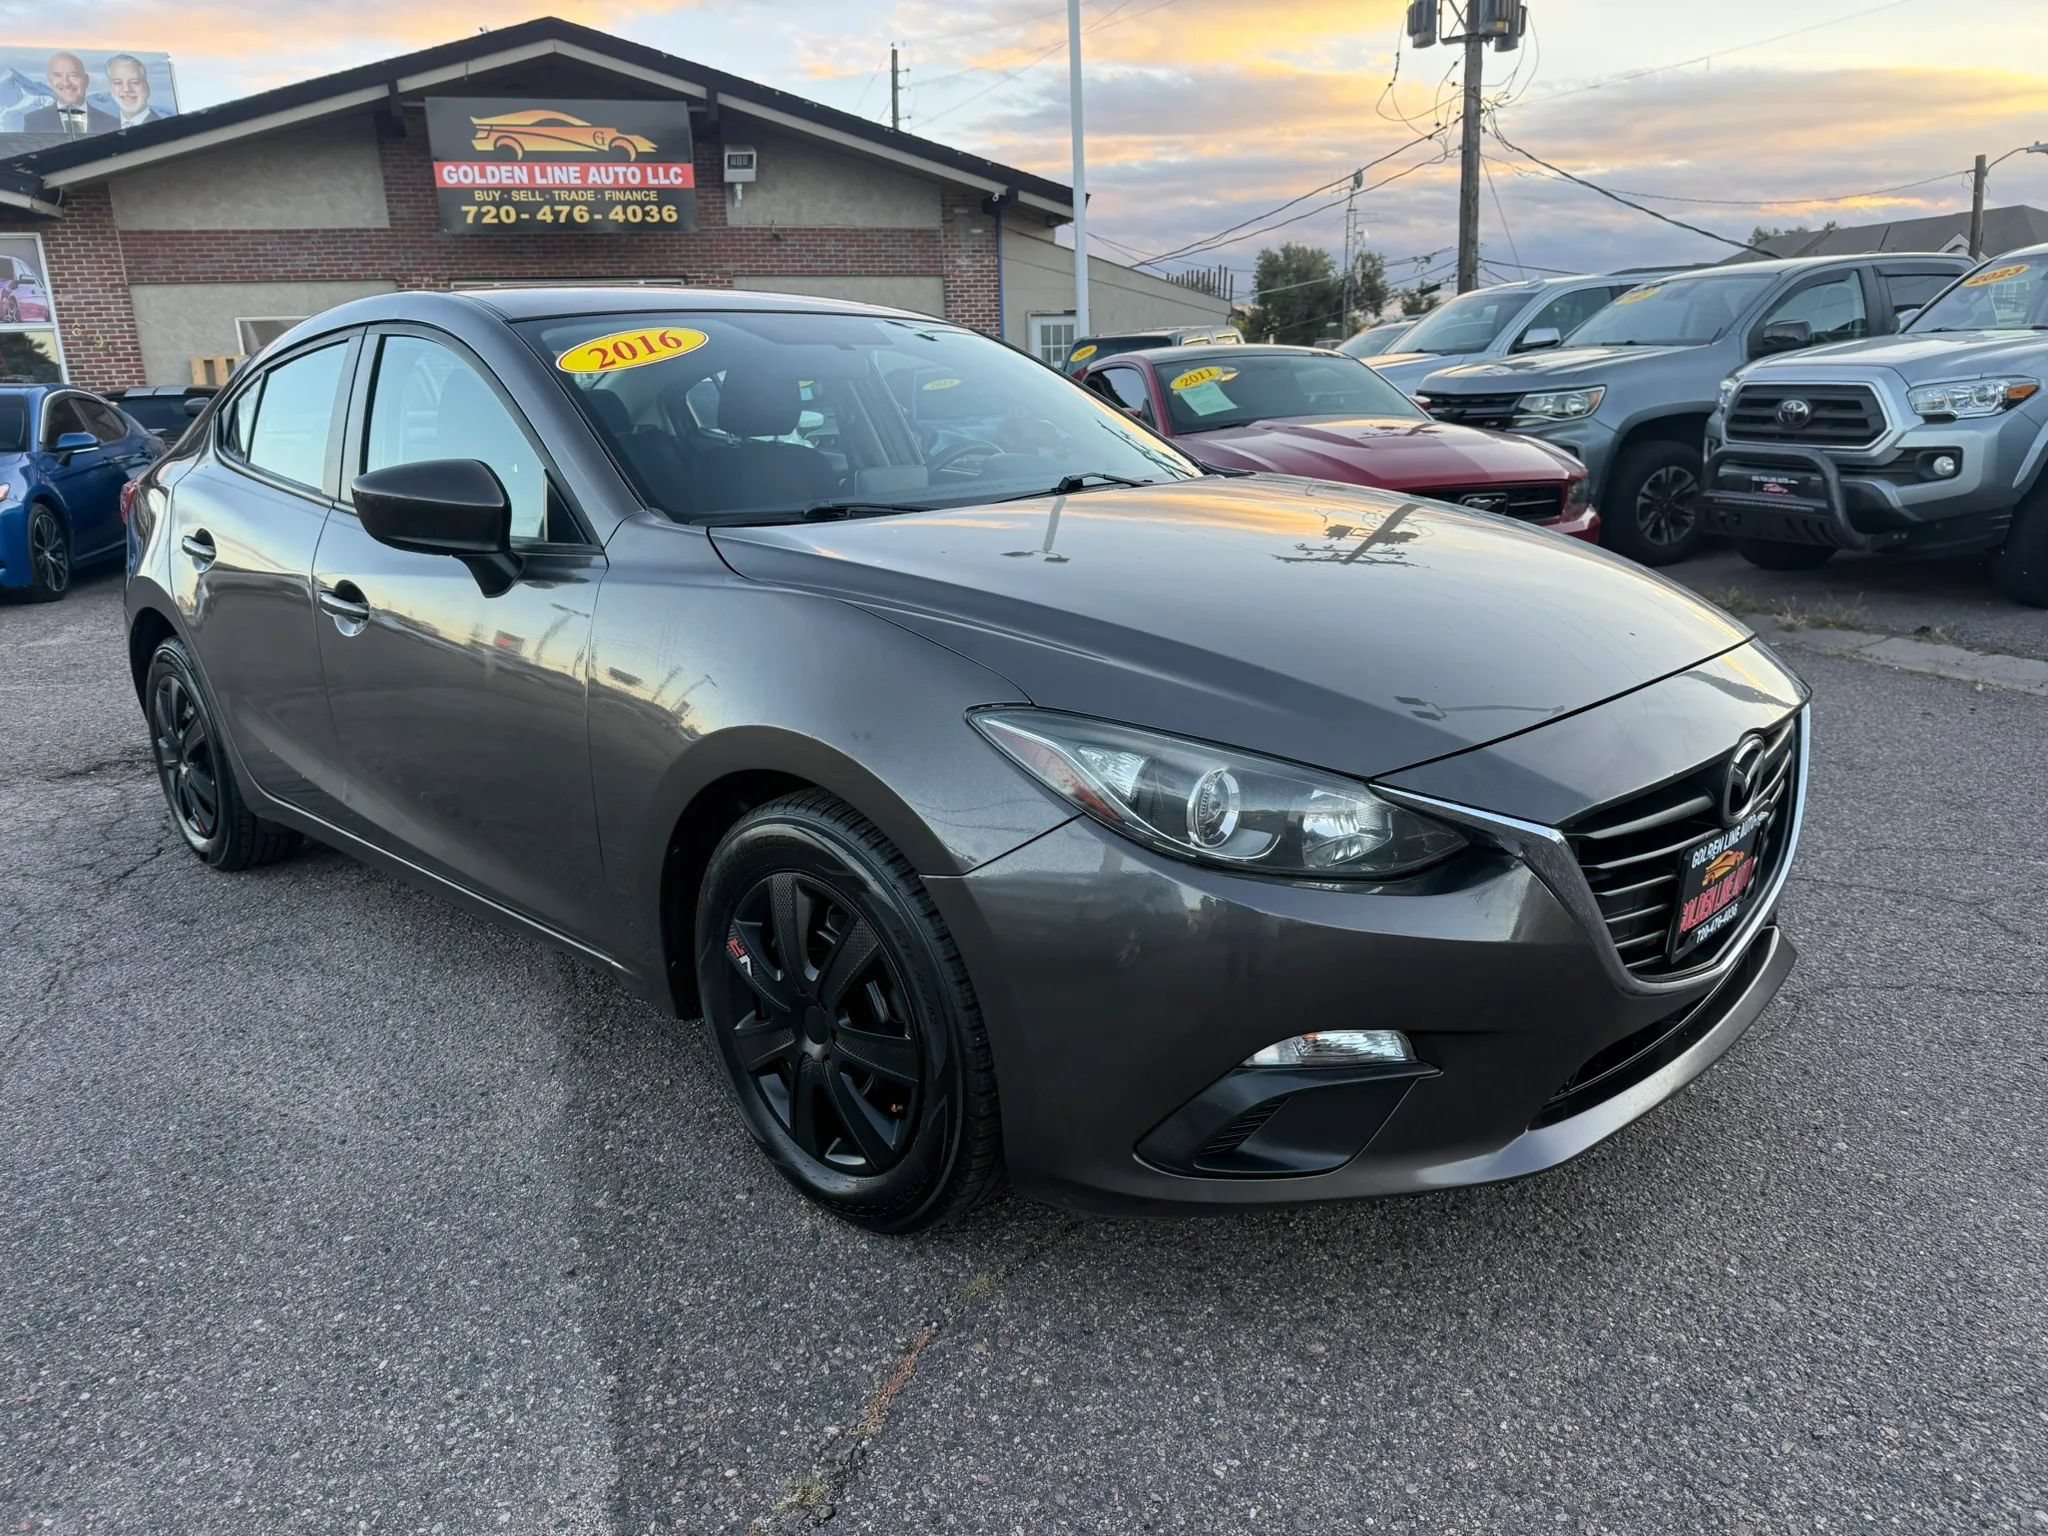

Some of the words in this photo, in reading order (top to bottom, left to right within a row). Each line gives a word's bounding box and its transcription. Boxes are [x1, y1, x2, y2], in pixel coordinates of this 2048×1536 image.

[442, 165, 529, 185] GOLDEN
[535, 166, 582, 185] LINE
[587, 166, 641, 185] AUTO
[647, 167, 683, 185] LLC
[474, 190, 501, 201] BUY
[511, 190, 544, 201] SELL
[553, 190, 595, 201] TRADE
[604, 190, 658, 201] FINANCE
[588, 330, 683, 369] 2016
[1180, 368, 1214, 387] 2011
